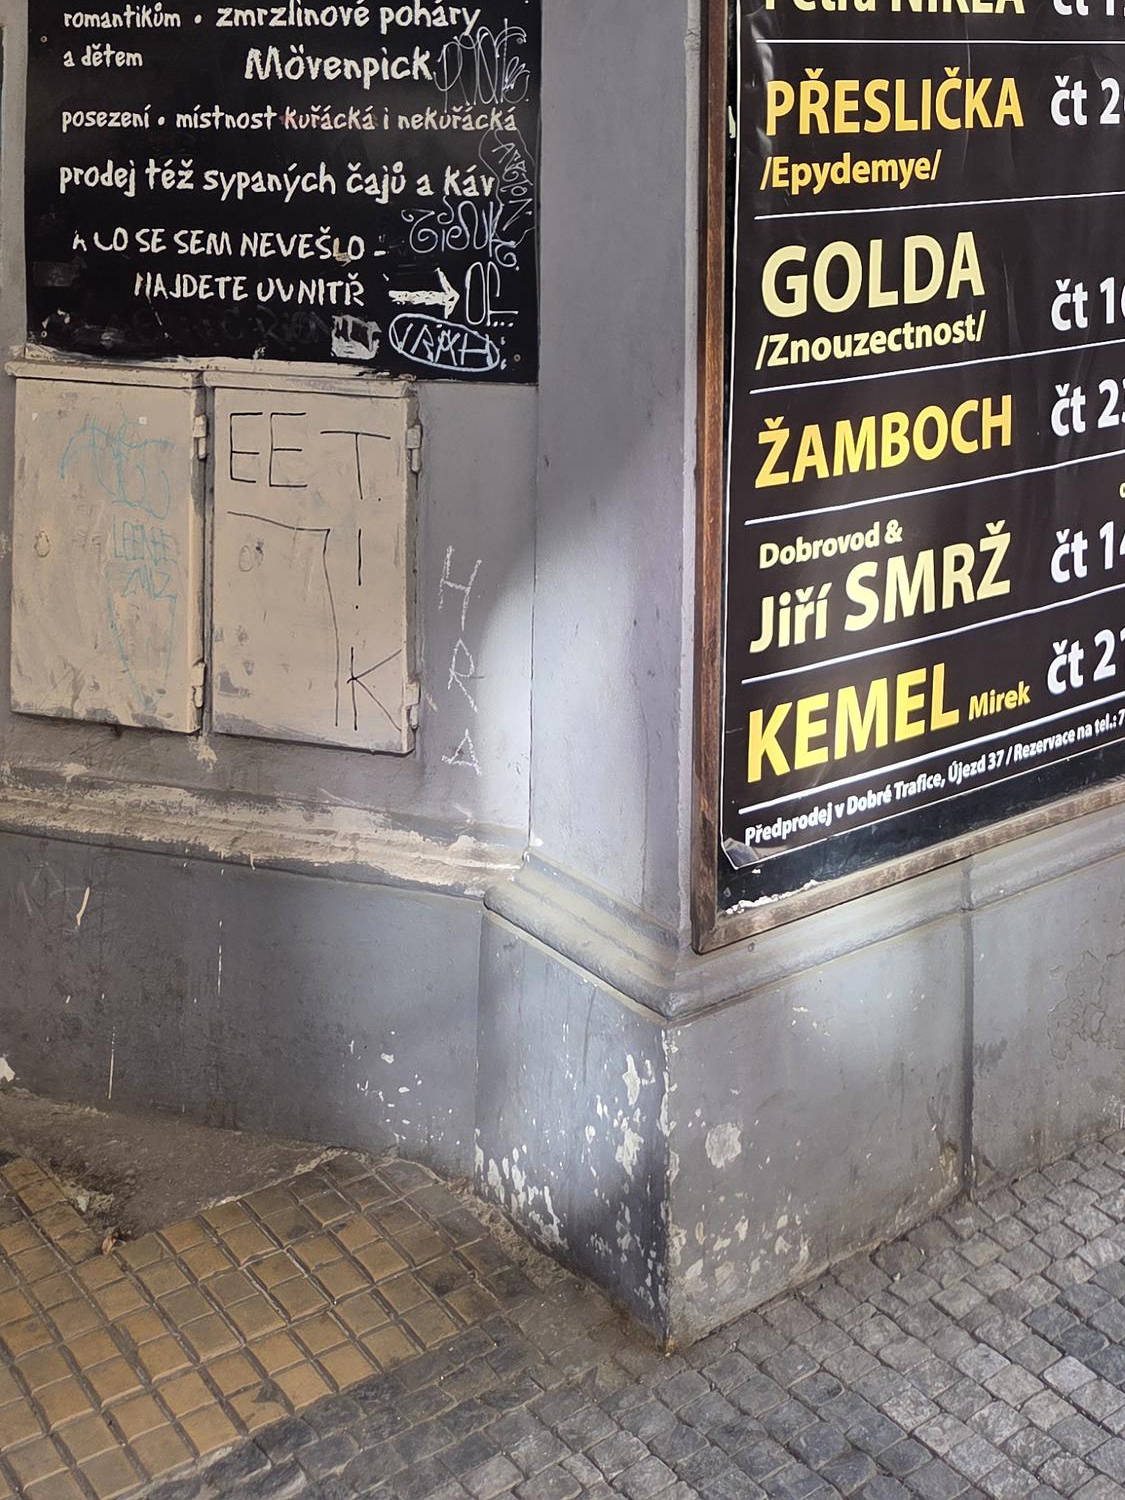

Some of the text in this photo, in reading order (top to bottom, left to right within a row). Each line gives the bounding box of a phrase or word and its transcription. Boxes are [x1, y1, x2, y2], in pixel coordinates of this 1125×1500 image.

[64, 2, 180, 28] romantikům
[64, 42, 433, 90] a dětem Mövenpick
[63, 104, 517, 133] posezení místnost kuřácká i nekuřácká
[765, 67, 1024, 136] PŘESLIČKA
[1051, 76, 1087, 126] čt
[60, 160, 135, 197] prodej
[145, 159, 193, 189] též
[203, 162, 335, 202] sypaných
[347, 161, 406, 204] čajů
[417, 174, 434, 196] a
[760, 149, 941, 195] /Epydemye/
[139, 228, 166, 252] SE
[174, 230, 232, 255] SEM
[241, 228, 364, 262] NEVEŠLO
[135, 272, 364, 306] NAJDETE UVNITŘ
[762, 231, 986, 319] GOLDA
[1052, 279, 1087, 330] čt
[755, 310, 986, 370] /Znouzectnost/
[755, 395, 1012, 488] ŽAMBOCH
[1052, 383, 1085, 436] čt
[759, 520, 902, 569] Dobrovod &
[750, 583, 832, 652] Jiří
[844, 521, 1011, 630] SMRŽ
[1051, 529, 1087, 583] čt
[747, 664, 959, 784] KEMEL
[969, 681, 1030, 720] Mirek
[1048, 639, 1084, 694] čt
[745, 804, 834, 846] Předprodej
[835, 803, 844, 818] v
[847, 785, 892, 815] Dobré
[893, 773, 946, 801] Trafice,
[948, 754, 985, 784] Újezd
[988, 749, 1004, 770] 37
[1006, 746, 1012, 765] /
[1014, 731, 1076, 761] Rezervace
[1077, 724, 1092, 740] na
[1094, 715, 1117, 734] tel.:
